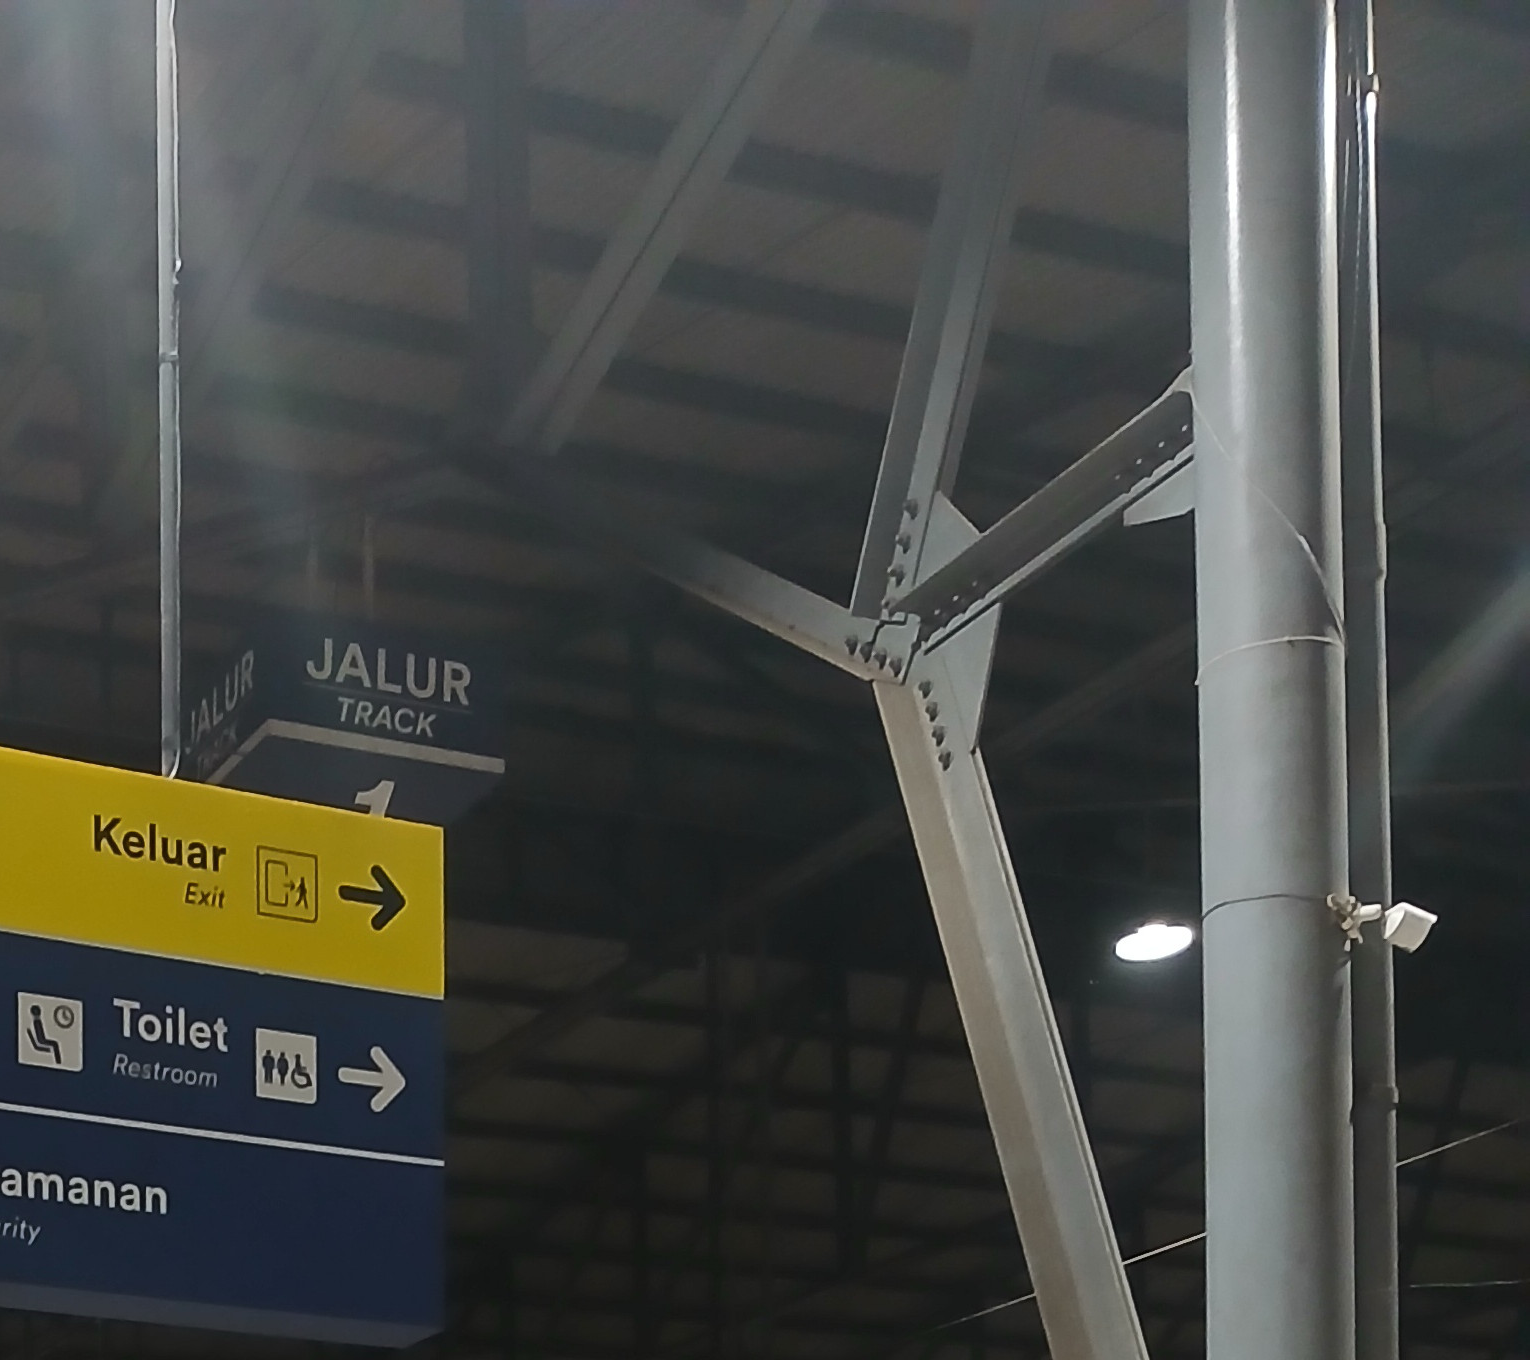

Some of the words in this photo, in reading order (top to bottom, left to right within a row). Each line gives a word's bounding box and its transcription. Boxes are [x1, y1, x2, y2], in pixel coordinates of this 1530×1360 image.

[306, 638, 472, 706] JALUR
[338, 696, 437, 738] TRACK
[92, 814, 227, 873] Keluar
[184, 881, 226, 910] Exit
[113, 998, 229, 1053] Toilet
[113, 1053, 218, 1089] Restroom
